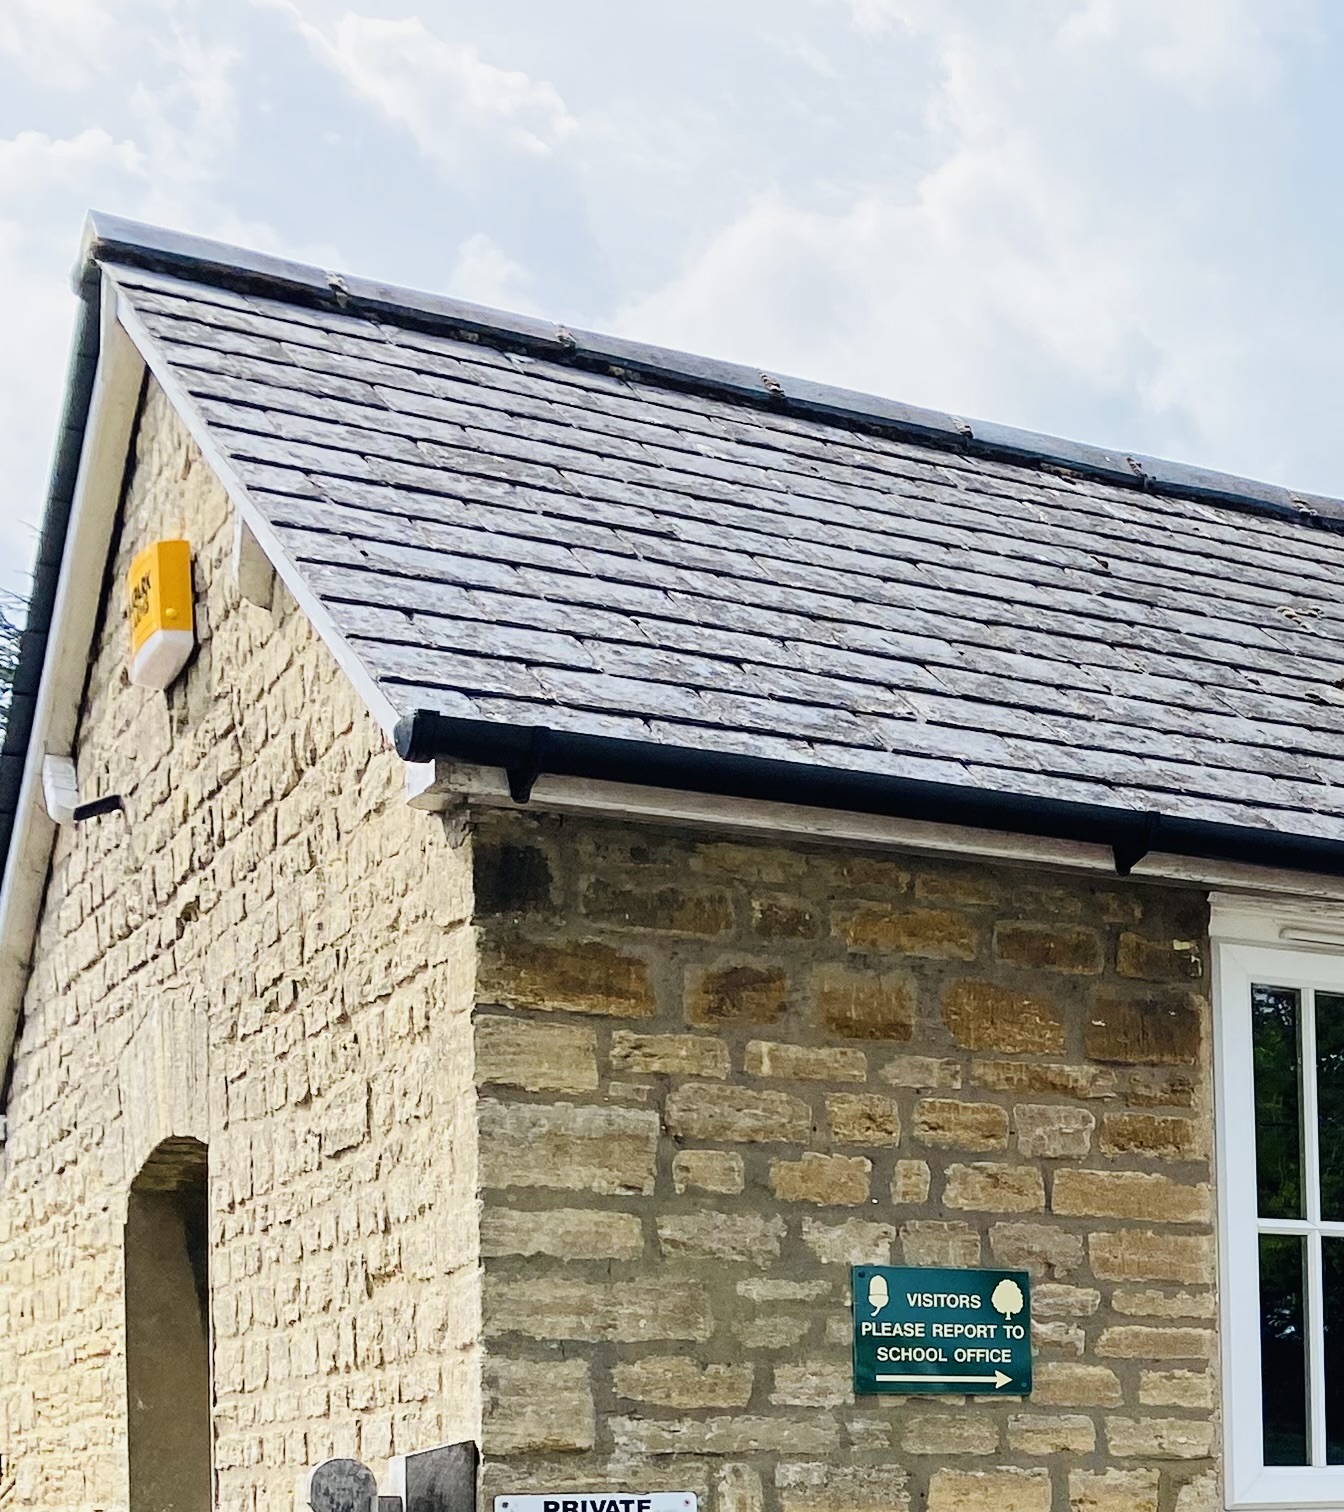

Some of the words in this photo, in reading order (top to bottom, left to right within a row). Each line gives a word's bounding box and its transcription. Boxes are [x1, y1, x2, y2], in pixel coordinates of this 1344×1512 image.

[906, 1293, 982, 1309] VISITORS
[861, 1321, 925, 1337] PLEASE
[932, 1323, 997, 1338] REPORT
[1003, 1325, 1025, 1339] TO
[877, 1347, 947, 1362] SCHOOL
[954, 1348, 1012, 1363] OFFICE
